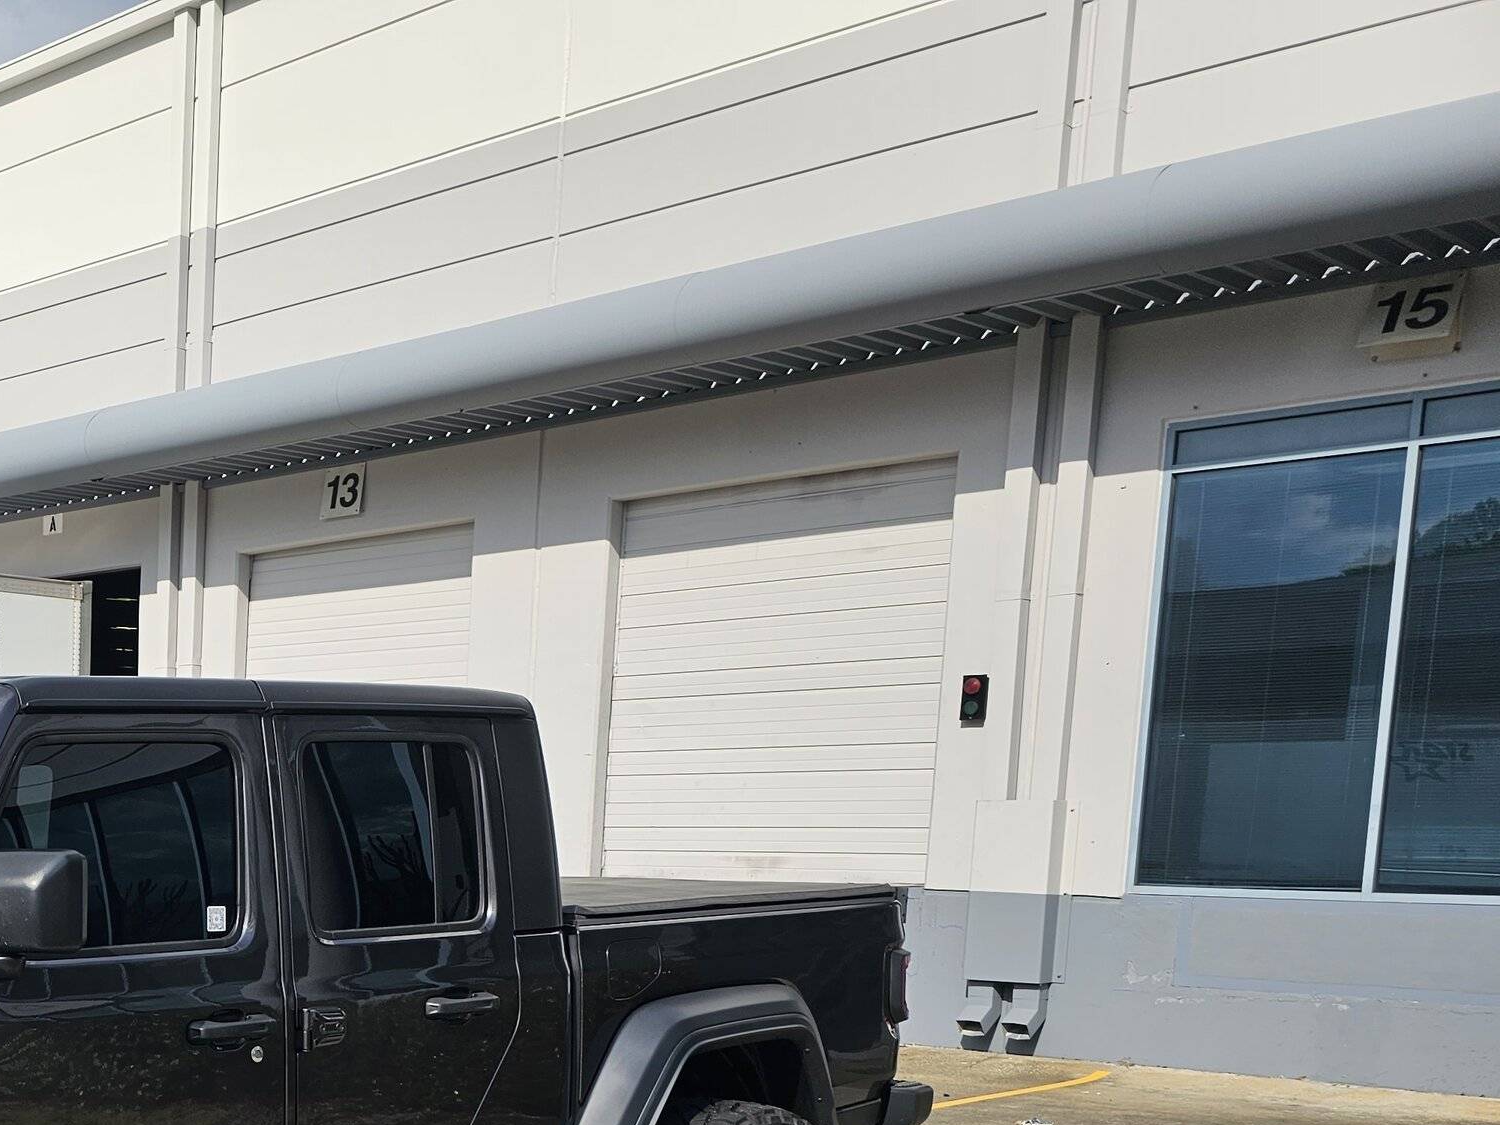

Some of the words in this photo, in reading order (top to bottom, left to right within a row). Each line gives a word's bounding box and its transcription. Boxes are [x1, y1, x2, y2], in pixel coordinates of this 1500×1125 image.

[1377, 283, 1454, 334] 15
[327, 472, 360, 510] 13
[49, 515, 57, 532] A
